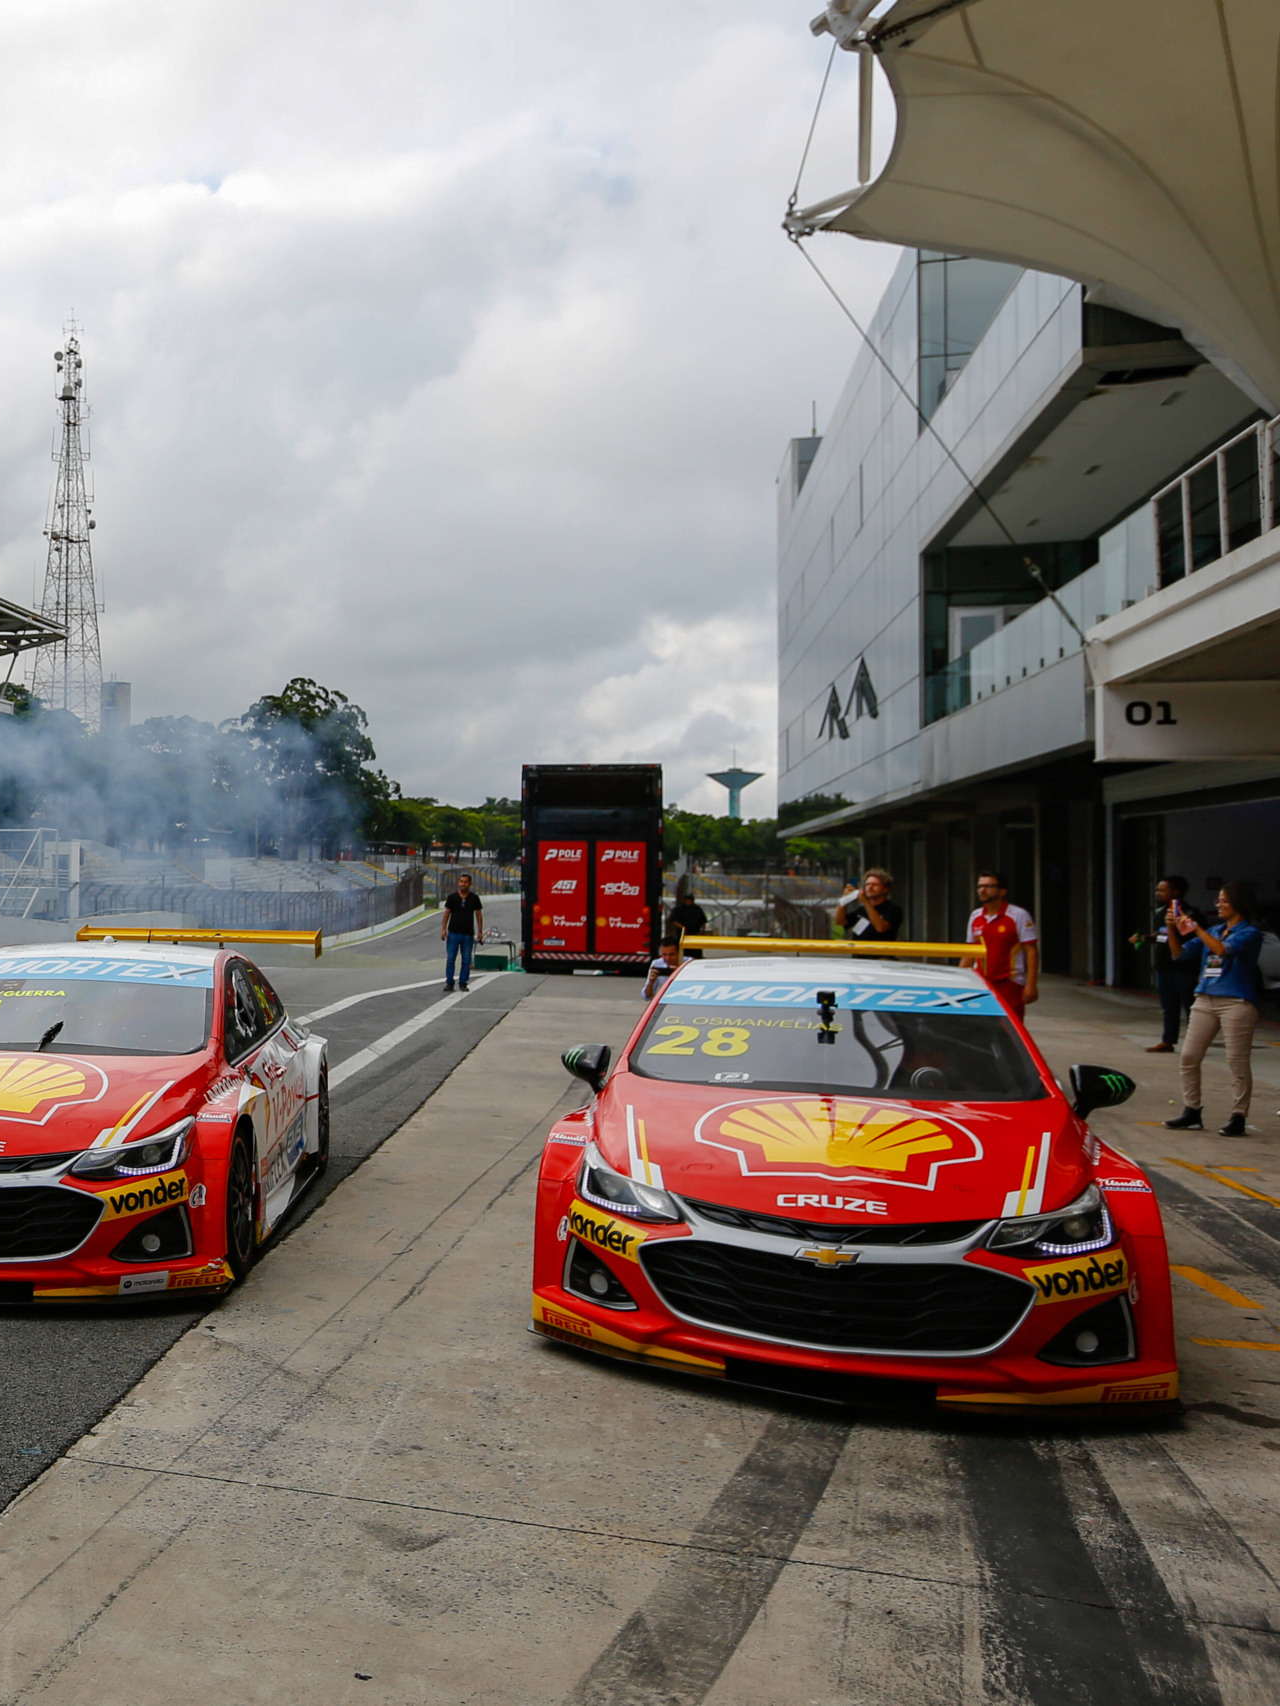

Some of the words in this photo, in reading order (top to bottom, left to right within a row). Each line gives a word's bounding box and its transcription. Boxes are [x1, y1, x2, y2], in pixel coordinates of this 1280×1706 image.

[1125, 701, 1178, 727] 01
[558, 849, 582, 858] POLE
[615, 850, 640, 860] POLE
[665, 1016, 685, 1025] G.
[693, 1017, 844, 1032] OSMAN/ELIAS
[646, 1026, 752, 1057] 28
[110, 1176, 186, 1215] vonder
[776, 1193, 889, 1216] CRUZE
[570, 1207, 634, 1255] vonder
[133, 1277, 165, 1287] motorola
[169, 1268, 226, 1288] PIRELLI
[1032, 1256, 1125, 1298] vonder
[542, 1306, 593, 1338] PIRELLI
[1100, 1382, 1170, 1402] PIRELLI
